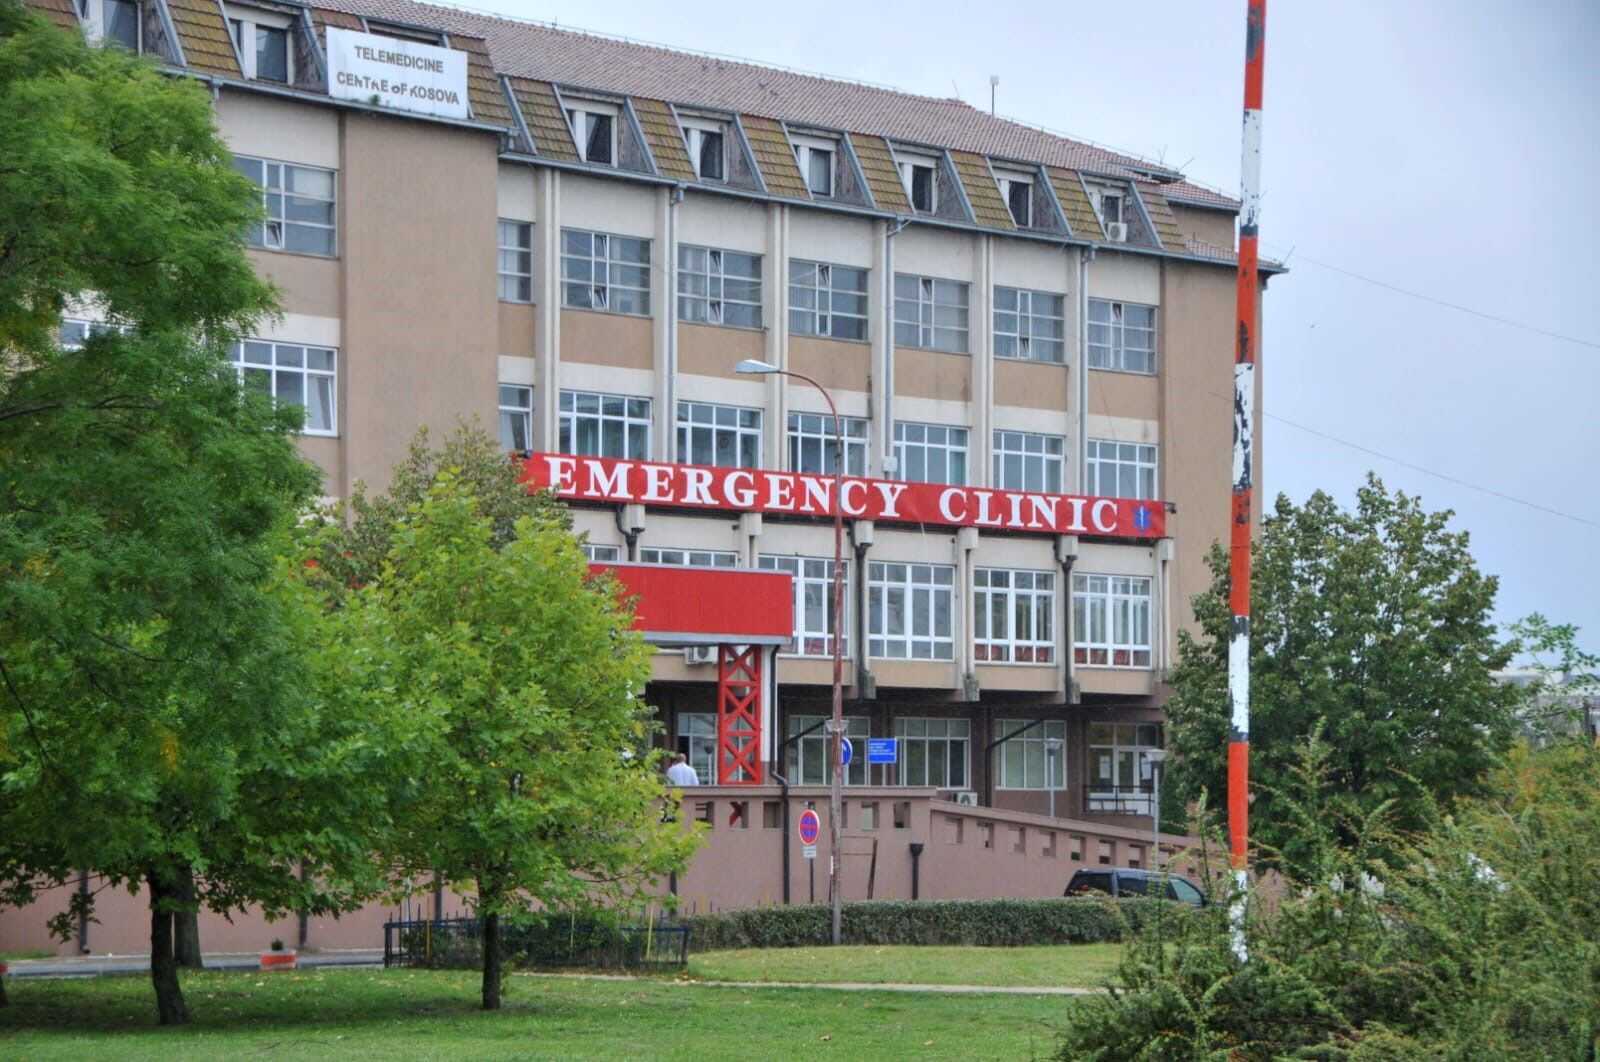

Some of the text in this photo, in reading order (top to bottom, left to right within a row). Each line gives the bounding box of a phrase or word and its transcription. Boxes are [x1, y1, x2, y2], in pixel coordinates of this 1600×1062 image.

[354, 45, 443, 73] TELEMEDICINE
[410, 85, 459, 105] KOSOVA
[543, 456, 1118, 534] EMERGENCY CLINIC
